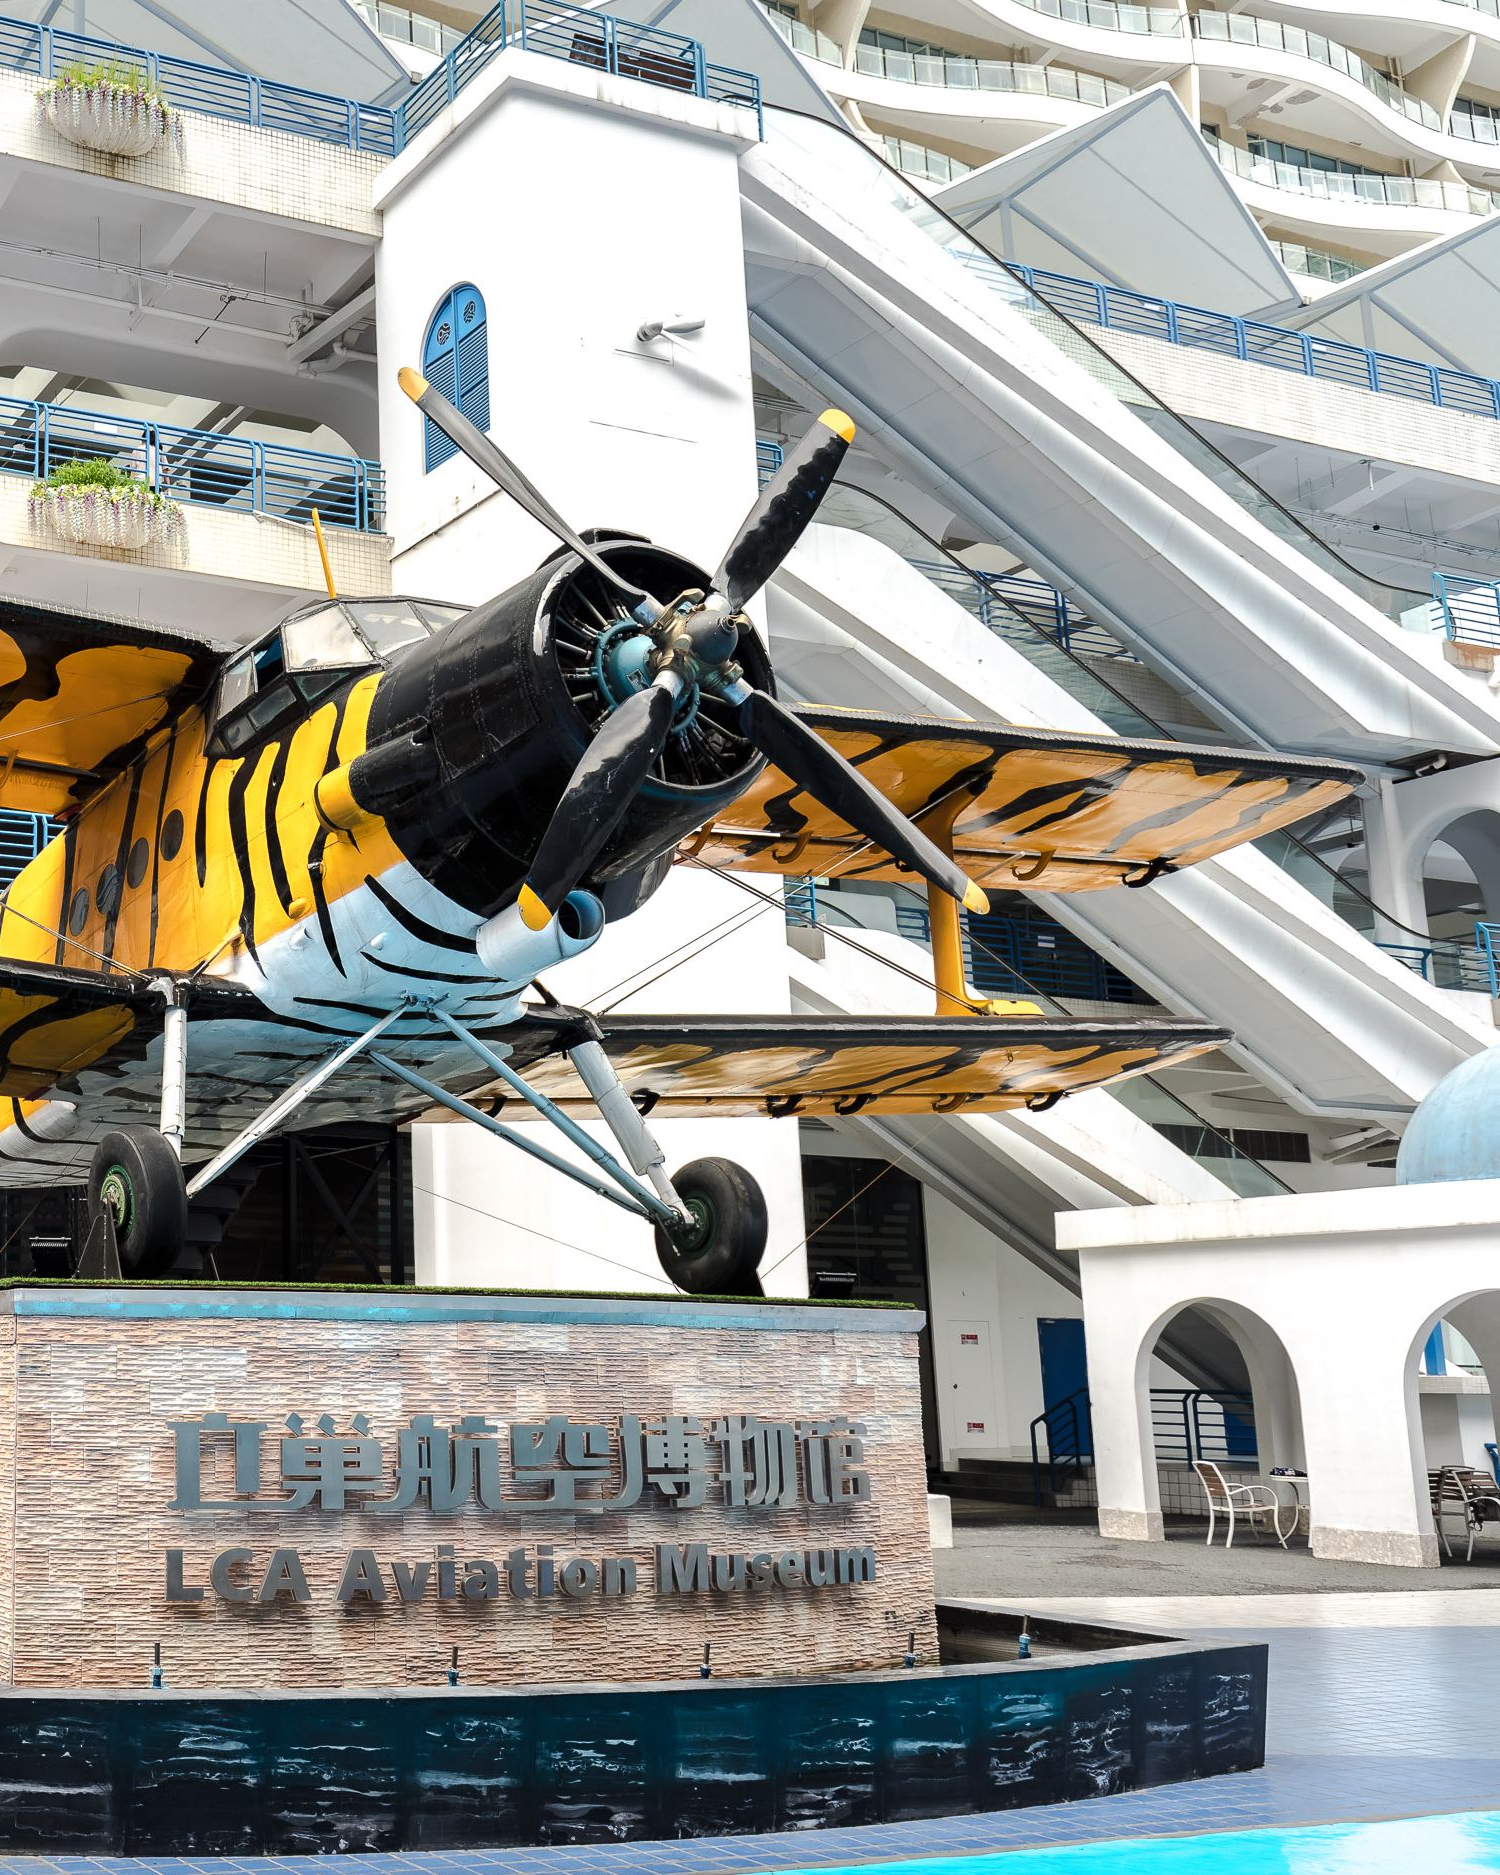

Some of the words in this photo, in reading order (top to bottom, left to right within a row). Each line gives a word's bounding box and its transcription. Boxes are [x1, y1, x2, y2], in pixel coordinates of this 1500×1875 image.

[166, 1412, 872, 1511] 立巢航空博物馆
[164, 1547, 312, 1602] LCA
[332, 1544, 638, 1602] Aviation
[653, 1543, 876, 1594] Museum
